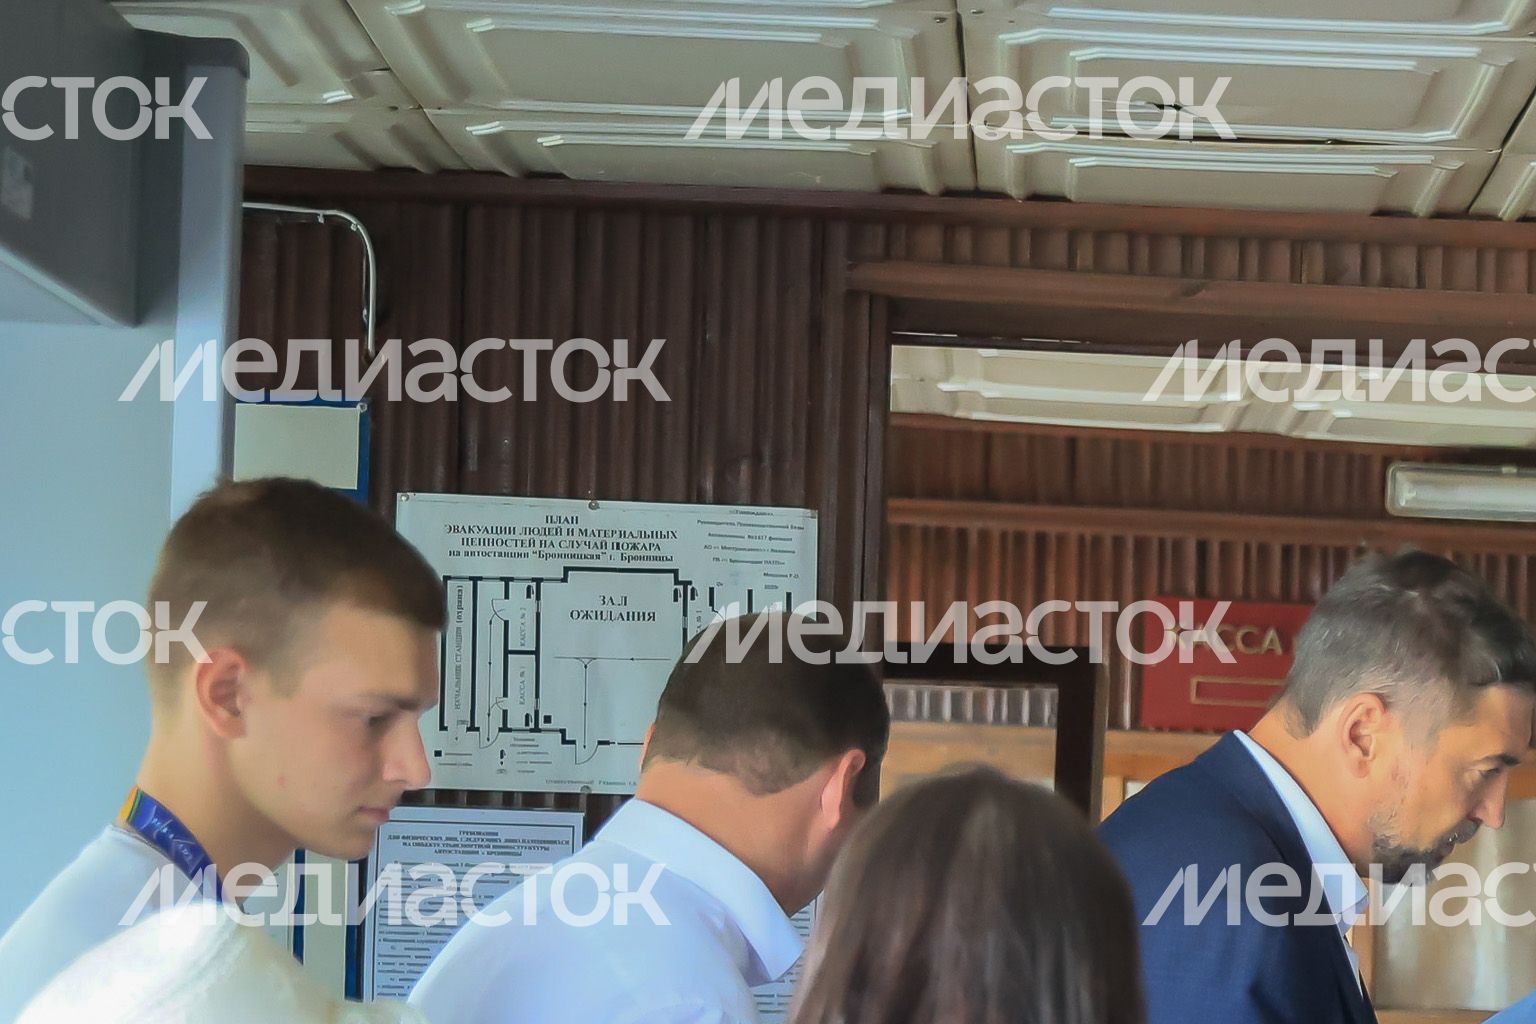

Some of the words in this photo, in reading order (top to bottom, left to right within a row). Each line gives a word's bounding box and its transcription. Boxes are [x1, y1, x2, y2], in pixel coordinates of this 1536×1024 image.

[545, 515, 579, 525] ПЛАН
[446, 524, 517, 536] ЭВАКУАЦИИ
[519, 526, 563, 538] ЛЮДЕЙ
[566, 528, 575, 537] И
[578, 528, 678, 540] МАТЕРИАЛЬНЫХ
[461, 536, 536, 549] ЦЕННОСТЕЙ
[539, 539, 556, 549] НА
[558, 539, 608, 551] СЛУЧАЙ
[611, 542, 661, 551] ПОЖАРА
[464, 551, 529, 559] автостанции
[620, 553, 674, 563] Бронницы
[598, 594, 629, 607] ЗАЛ
[569, 608, 657, 623] ОЖИДАНИЯ
